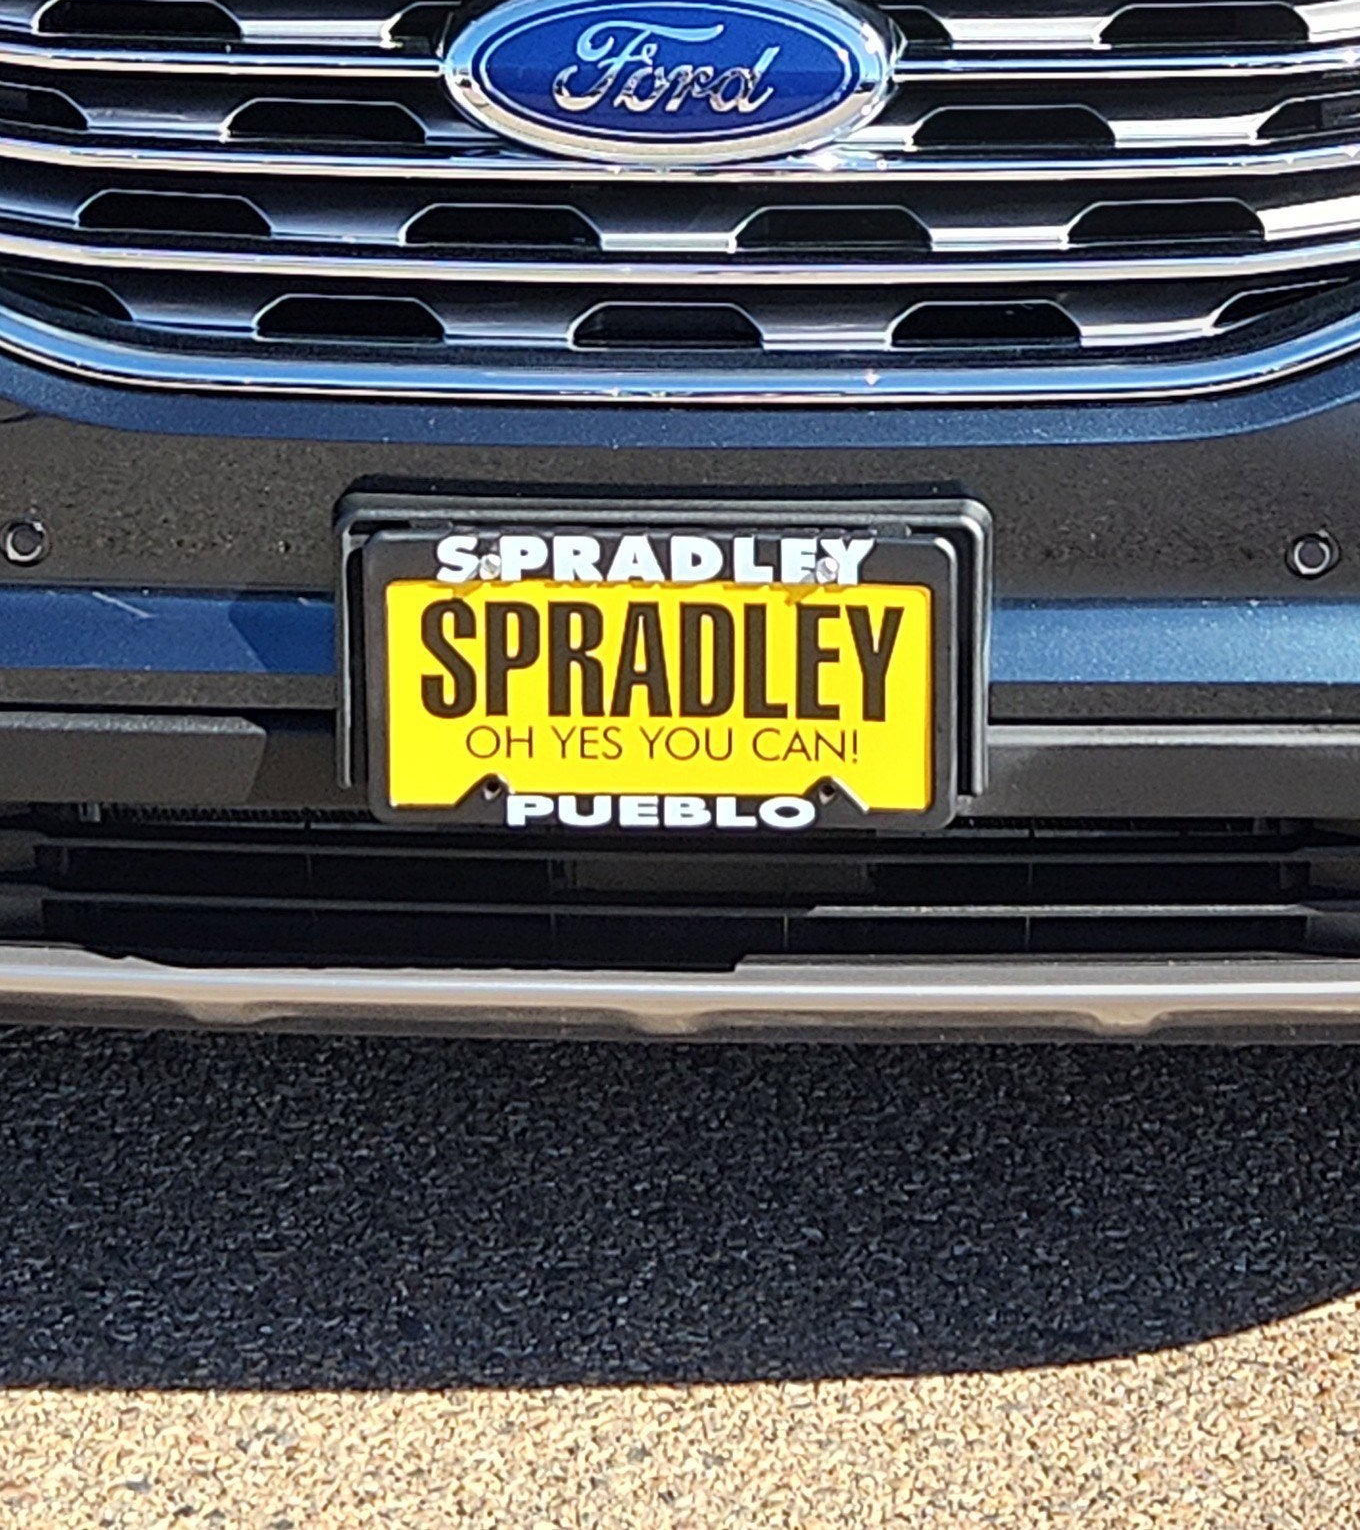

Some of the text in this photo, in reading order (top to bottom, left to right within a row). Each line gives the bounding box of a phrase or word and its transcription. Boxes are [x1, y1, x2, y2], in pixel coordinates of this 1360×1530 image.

[553, 19, 780, 113] Ford
[435, 535, 876, 585] SPRADLEY
[420, 599, 906, 723] SPRADLEY
[465, 725, 860, 763] OH YES YOU CAN!
[505, 794, 816, 829] PUEBLO
